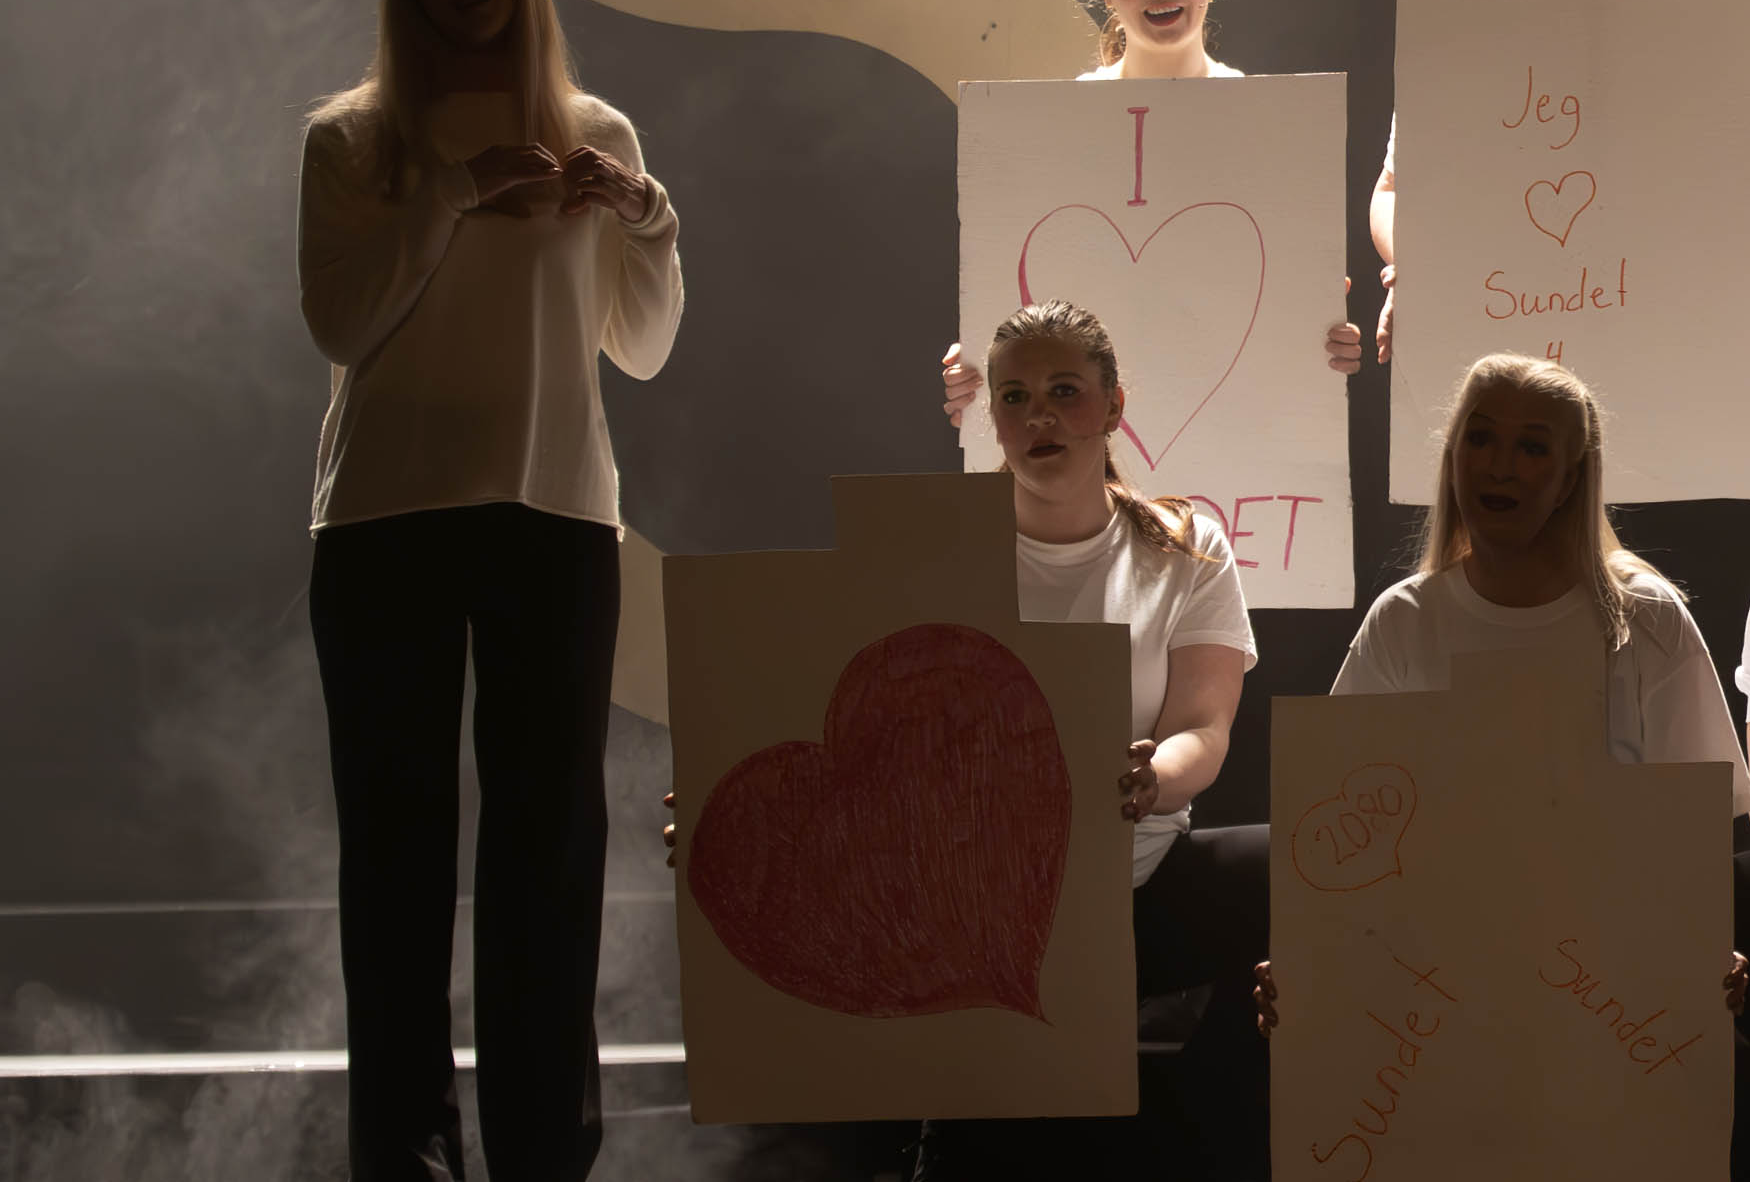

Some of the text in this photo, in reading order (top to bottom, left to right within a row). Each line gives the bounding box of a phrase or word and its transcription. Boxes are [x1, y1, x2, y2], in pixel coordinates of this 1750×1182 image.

[1501, 65, 1581, 150] Jeg
[1126, 105, 1150, 207] I
[1485, 257, 1631, 320] Sundet
[1538, 938, 1704, 1075] Sundet
